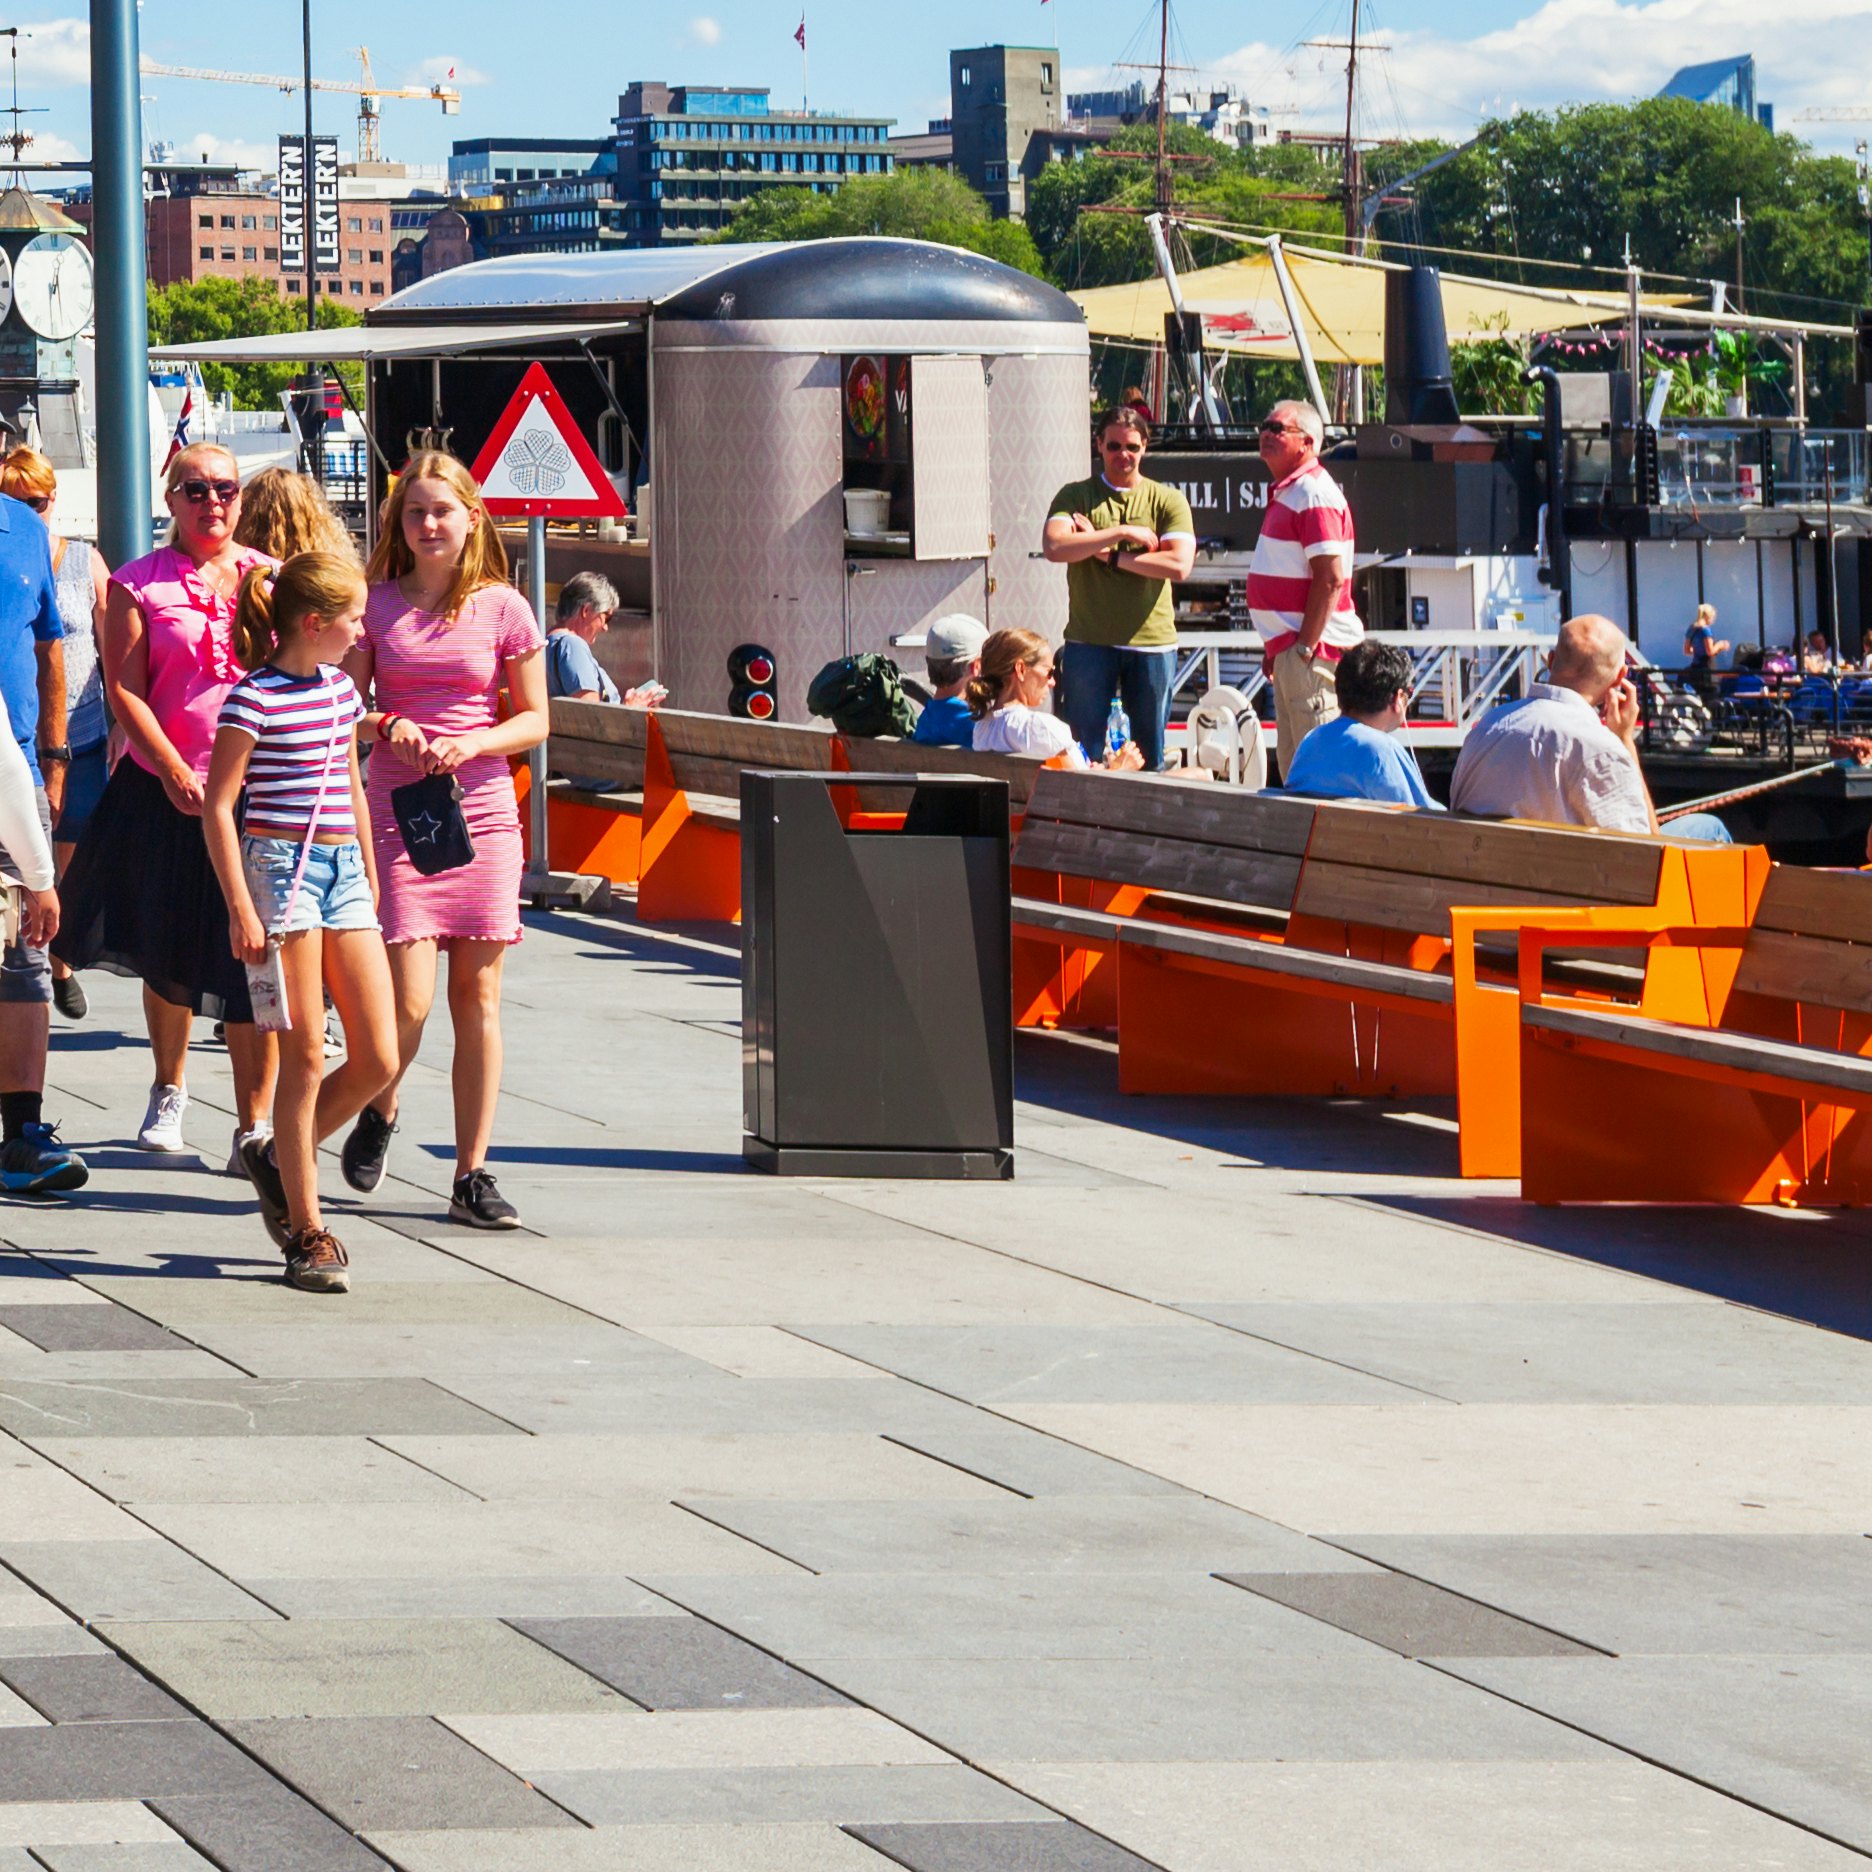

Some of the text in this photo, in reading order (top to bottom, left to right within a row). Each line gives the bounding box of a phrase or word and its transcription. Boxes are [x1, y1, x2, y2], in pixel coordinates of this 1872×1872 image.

[281, 146, 304, 266] LEKTER'N
[315, 144, 338, 263] LEKTER'N
[1239, 481, 1269, 508] SJ
